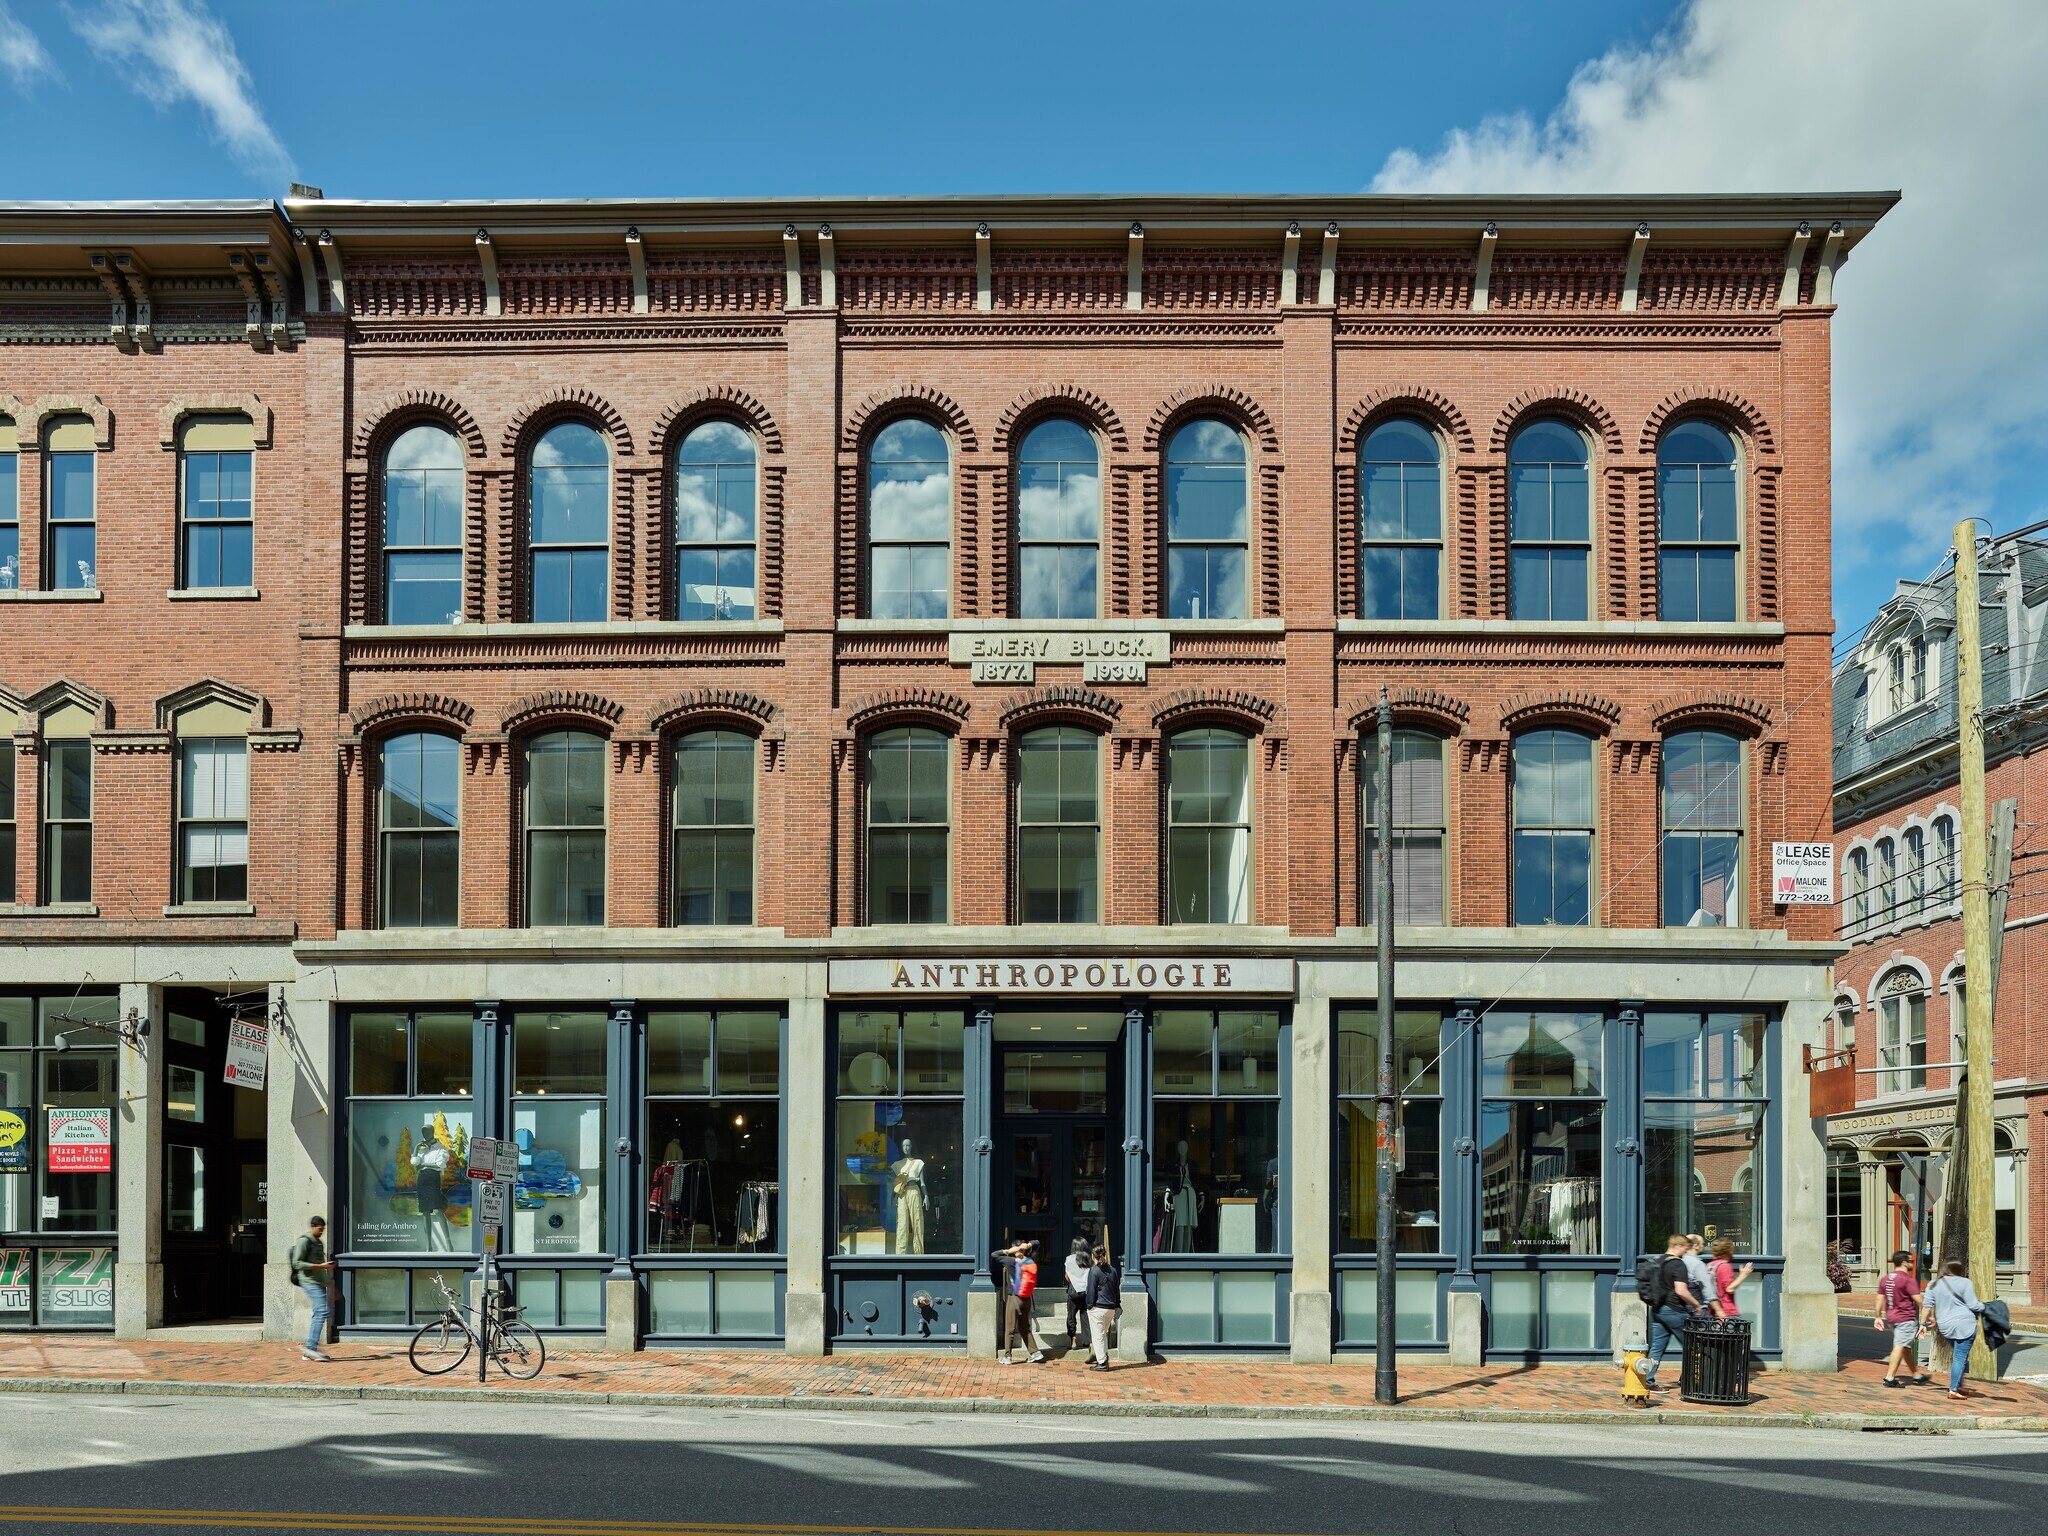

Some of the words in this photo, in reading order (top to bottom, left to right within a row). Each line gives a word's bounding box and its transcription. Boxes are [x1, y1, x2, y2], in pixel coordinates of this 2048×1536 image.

[971, 638, 1049, 656] EMERY
[1070, 638, 1152, 656] BLOCK.
[1776, 845, 1784, 856] FOR
[1785, 846, 1830, 858] LEASE
[1796, 877, 1827, 886] MALONE
[1778, 893, 1830, 902] 772-2422
[890, 964, 1232, 987] ANTHROPOLOGIE
[231, 1023, 240, 1035] FOR
[240, 1026, 268, 1042] LEASE
[236, 1068, 263, 1081] MALONE
[51, 1110, 109, 1118] ANTHONY'S
[1833, 1114, 1897, 1131] WOODMAN
[52, 1146, 76, 1154] Pizza
[83, 1146, 108, 1154] Pasta
[56, 1155, 104, 1163] Sandwiches
[55, 1289, 112, 1306] SLIC
